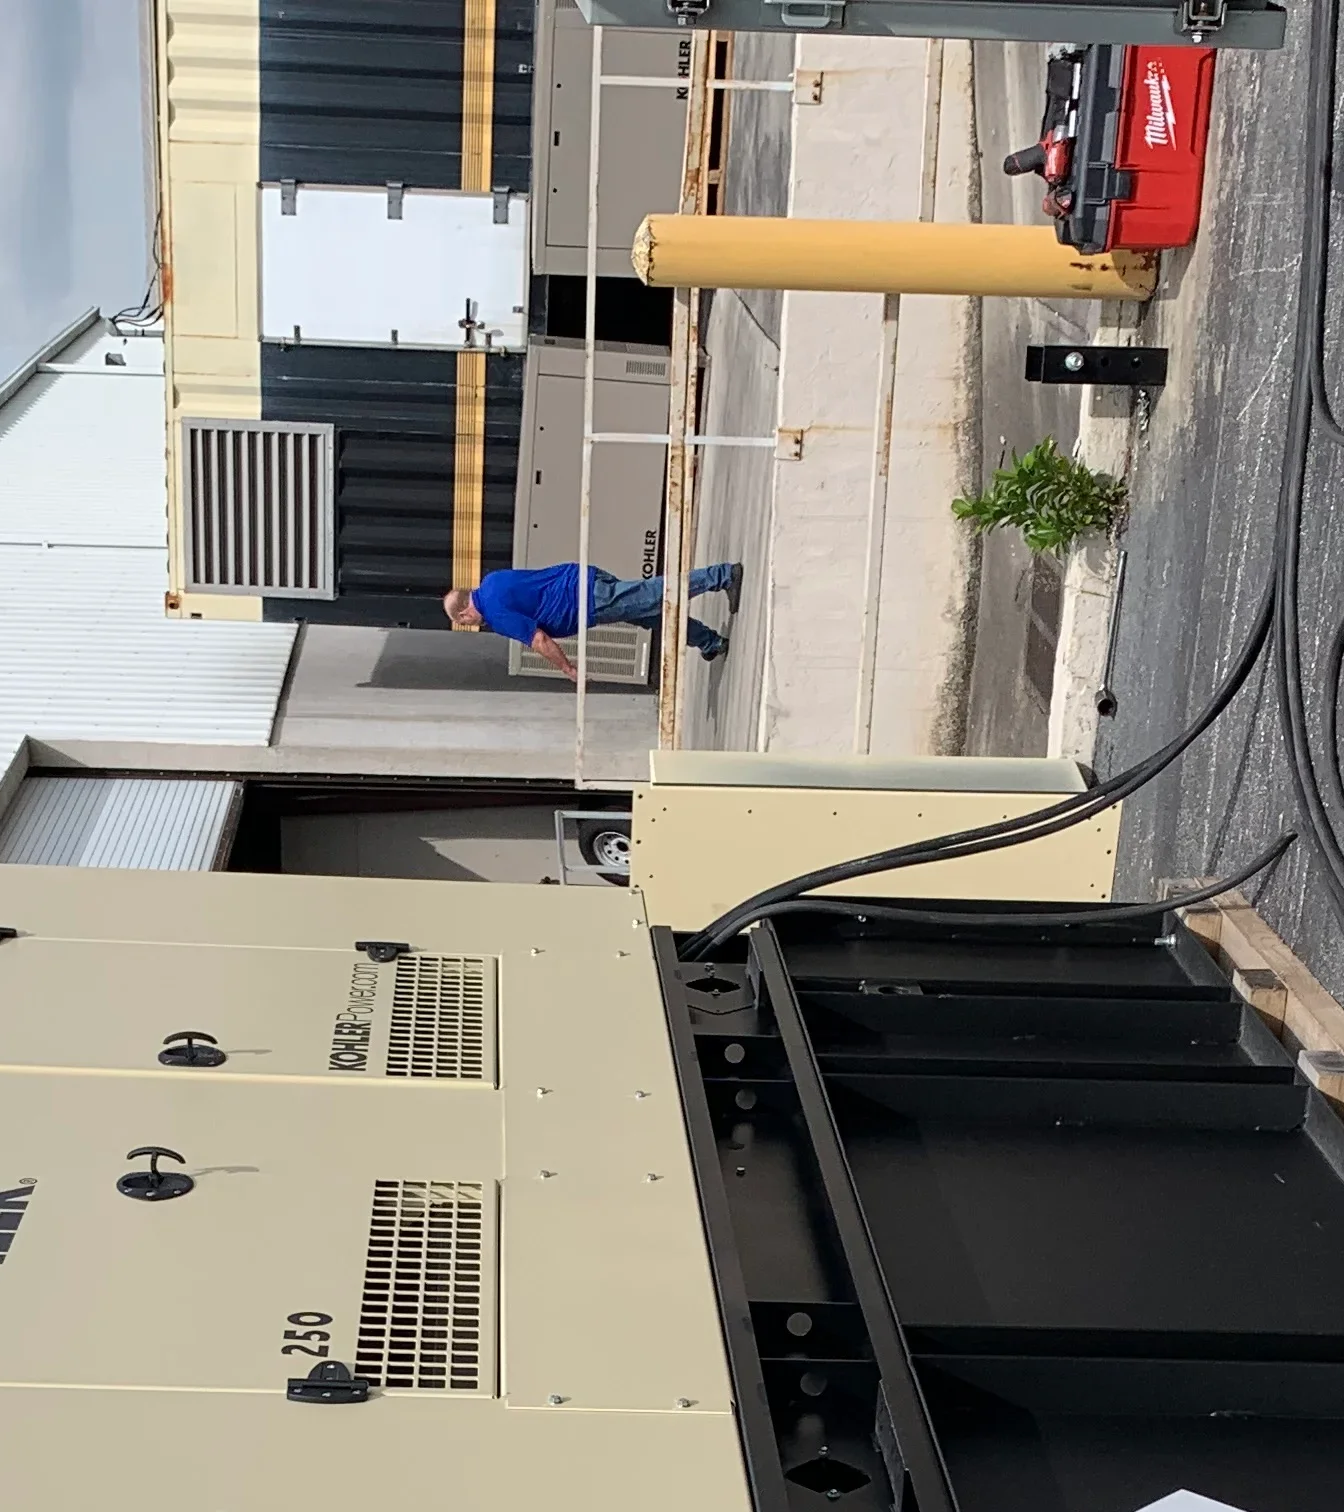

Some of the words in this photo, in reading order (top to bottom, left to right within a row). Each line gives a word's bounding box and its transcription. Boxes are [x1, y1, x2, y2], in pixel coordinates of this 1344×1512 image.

[676, 41, 691, 100] KHLER
[328, 963, 379, 1072] KOHLERPower.com
[281, 1311, 333, 1358] 250
